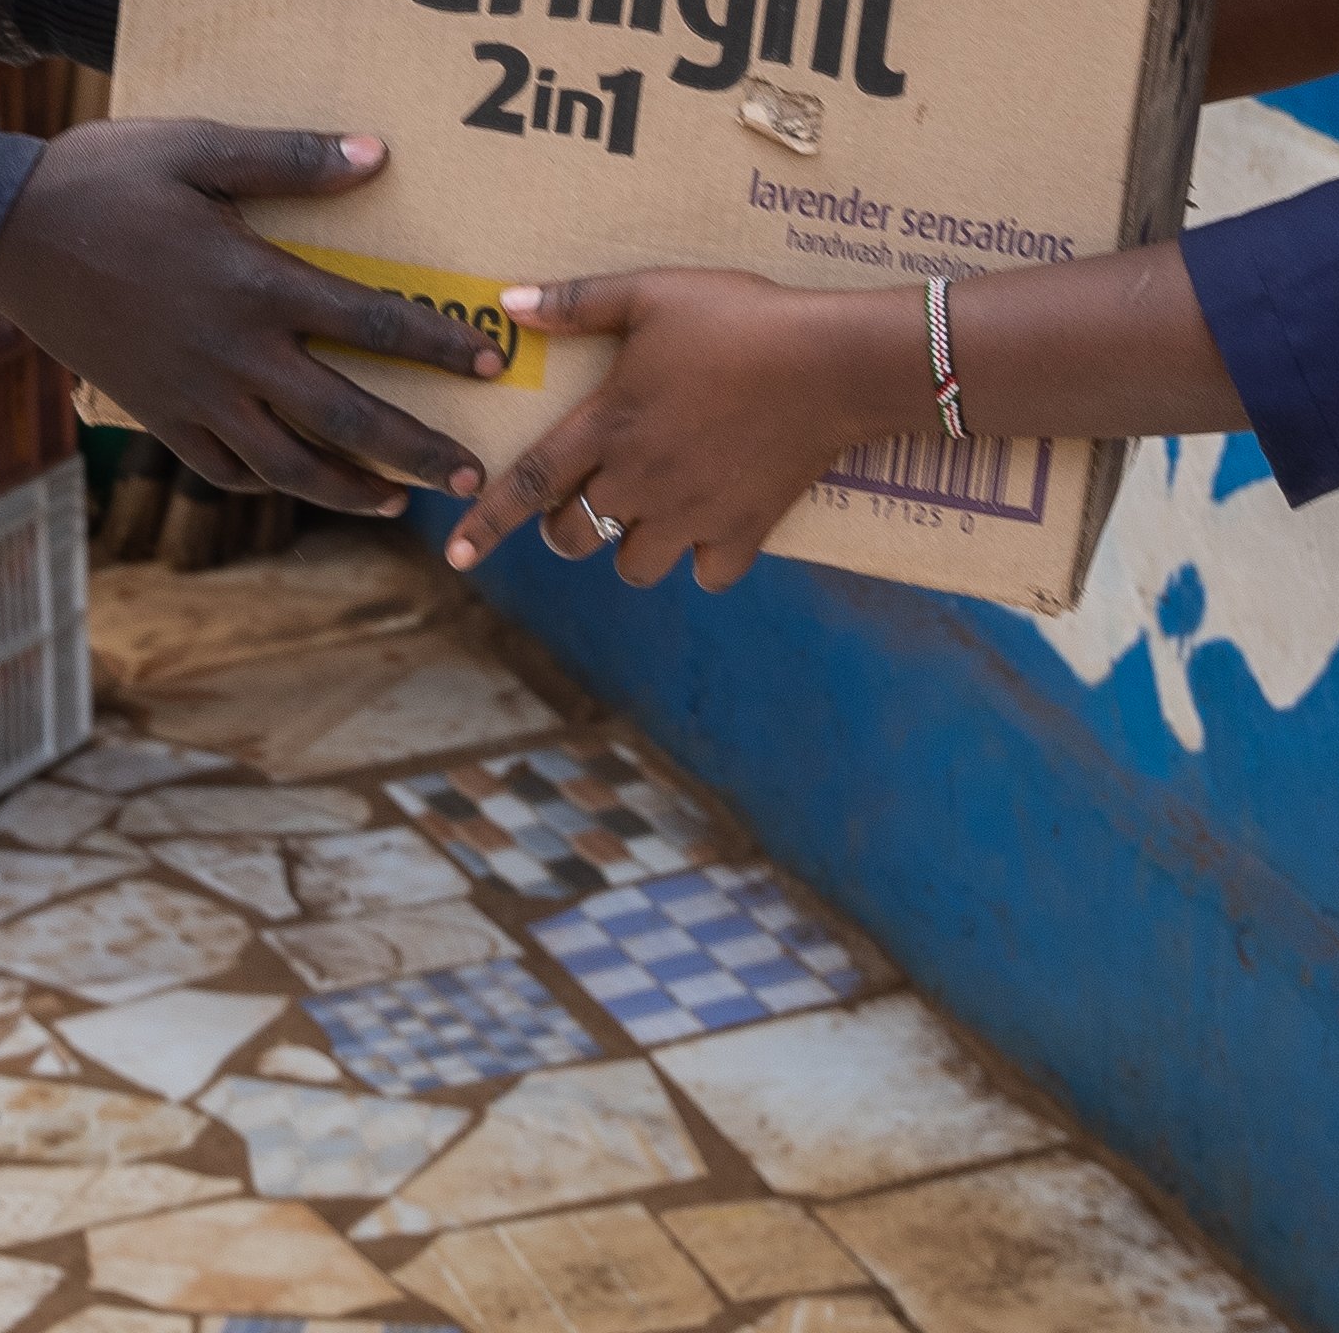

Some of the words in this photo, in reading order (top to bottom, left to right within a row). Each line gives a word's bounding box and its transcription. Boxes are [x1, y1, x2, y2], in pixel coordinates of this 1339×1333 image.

[461, 41, 645, 157] 2in1
[749, 166, 894, 232] lavender
[898, 205, 1077, 265] sensations
[784, 221, 894, 271] handwash
